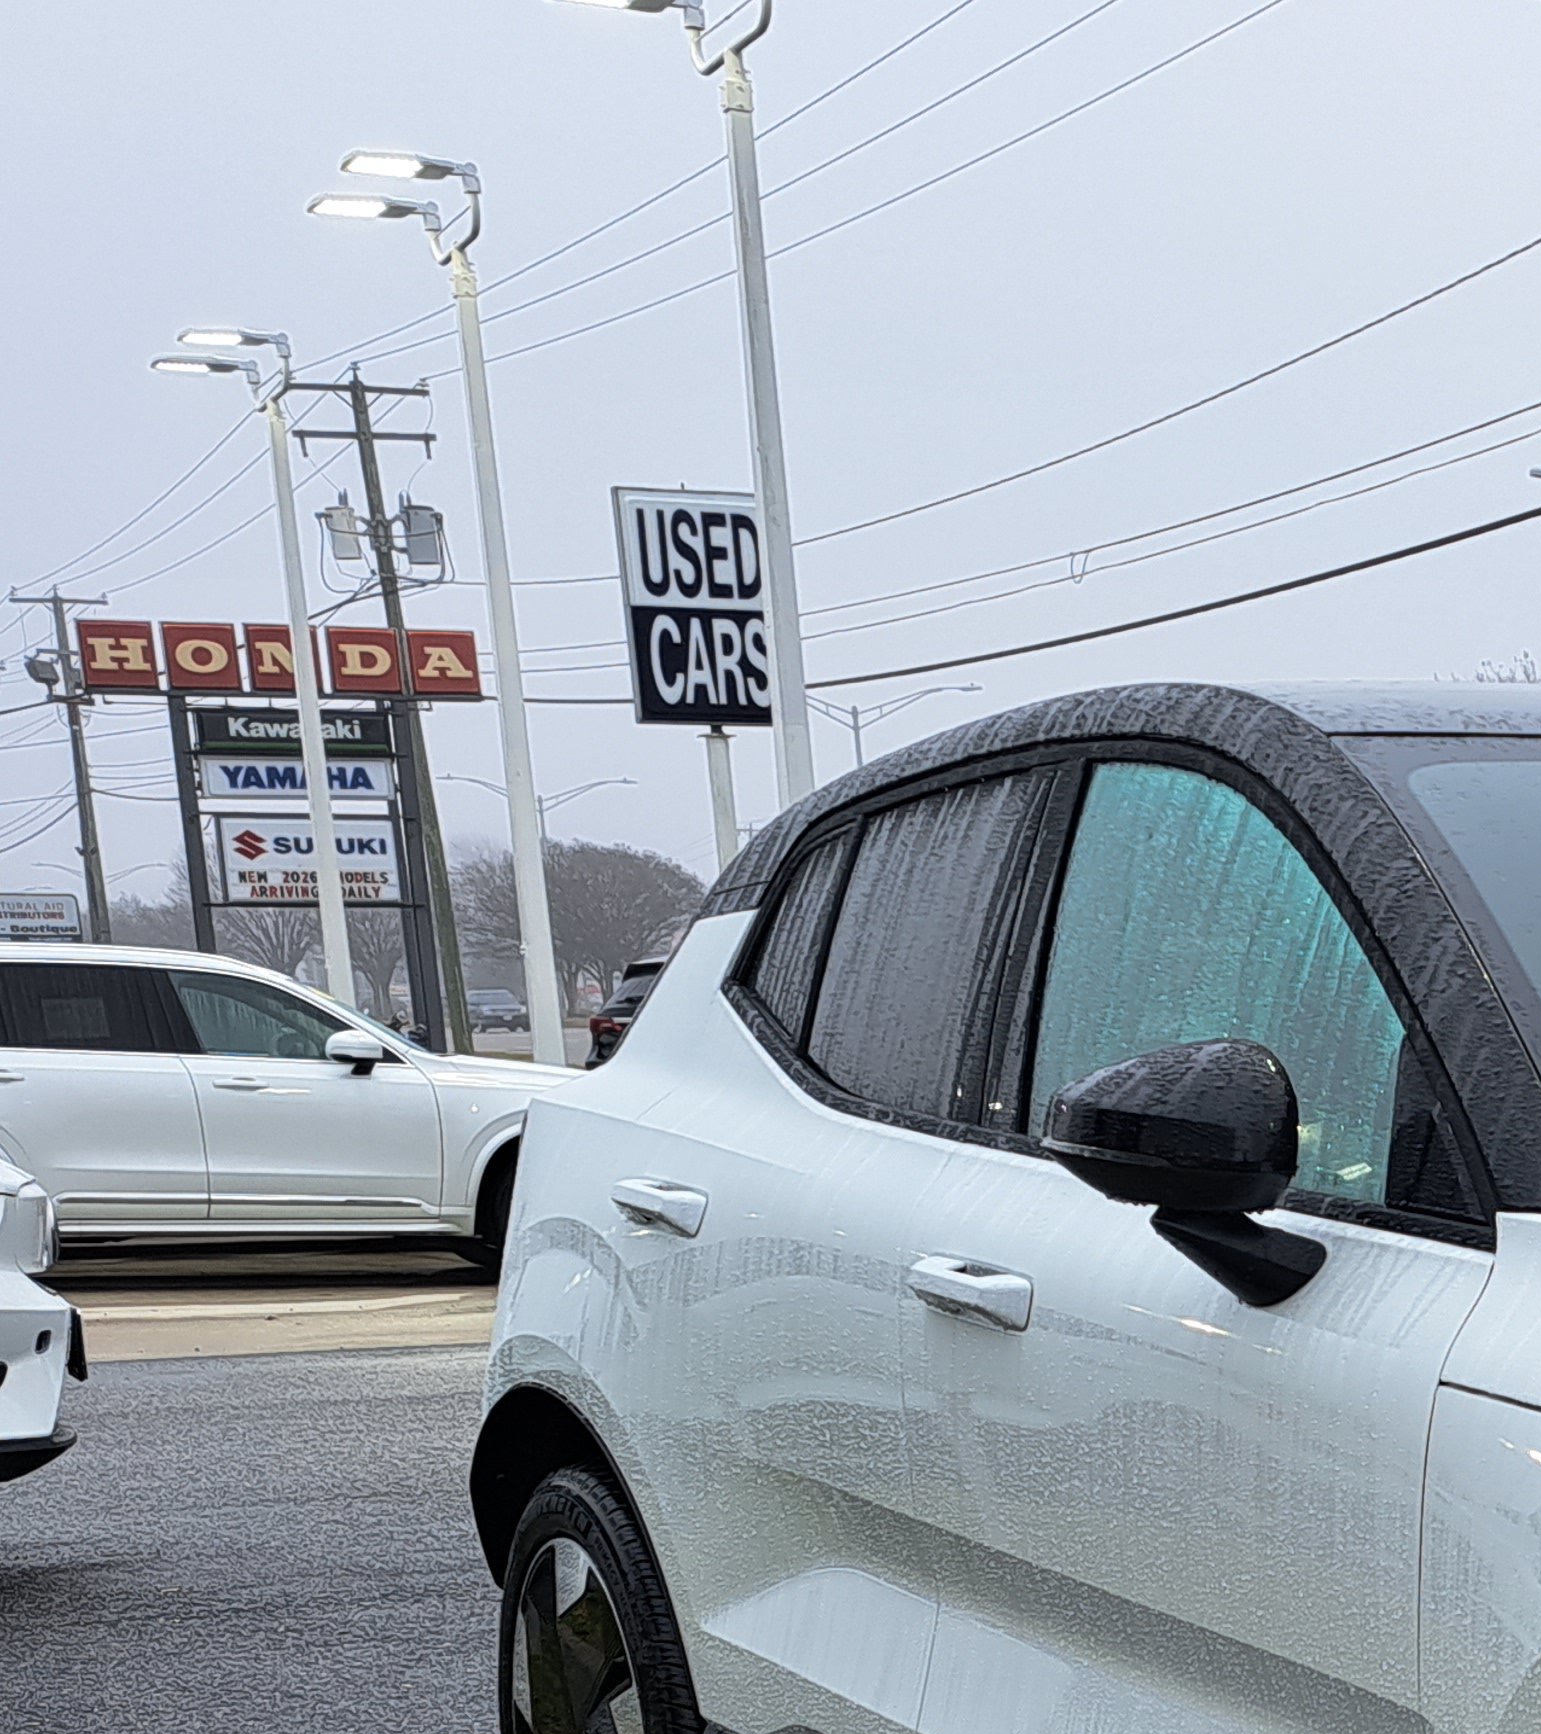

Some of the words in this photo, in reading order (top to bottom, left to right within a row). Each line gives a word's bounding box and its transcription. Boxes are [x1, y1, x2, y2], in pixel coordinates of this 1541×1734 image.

[635, 507, 763, 600] USED
[650, 613, 772, 708] CARS
[226, 716, 363, 740] Kawaaki
[272, 836, 388, 855] SUUKI
[238, 870, 269, 884] NEW
[282, 870, 318, 884] 2026
[250, 885, 319, 899] ARRIVING
